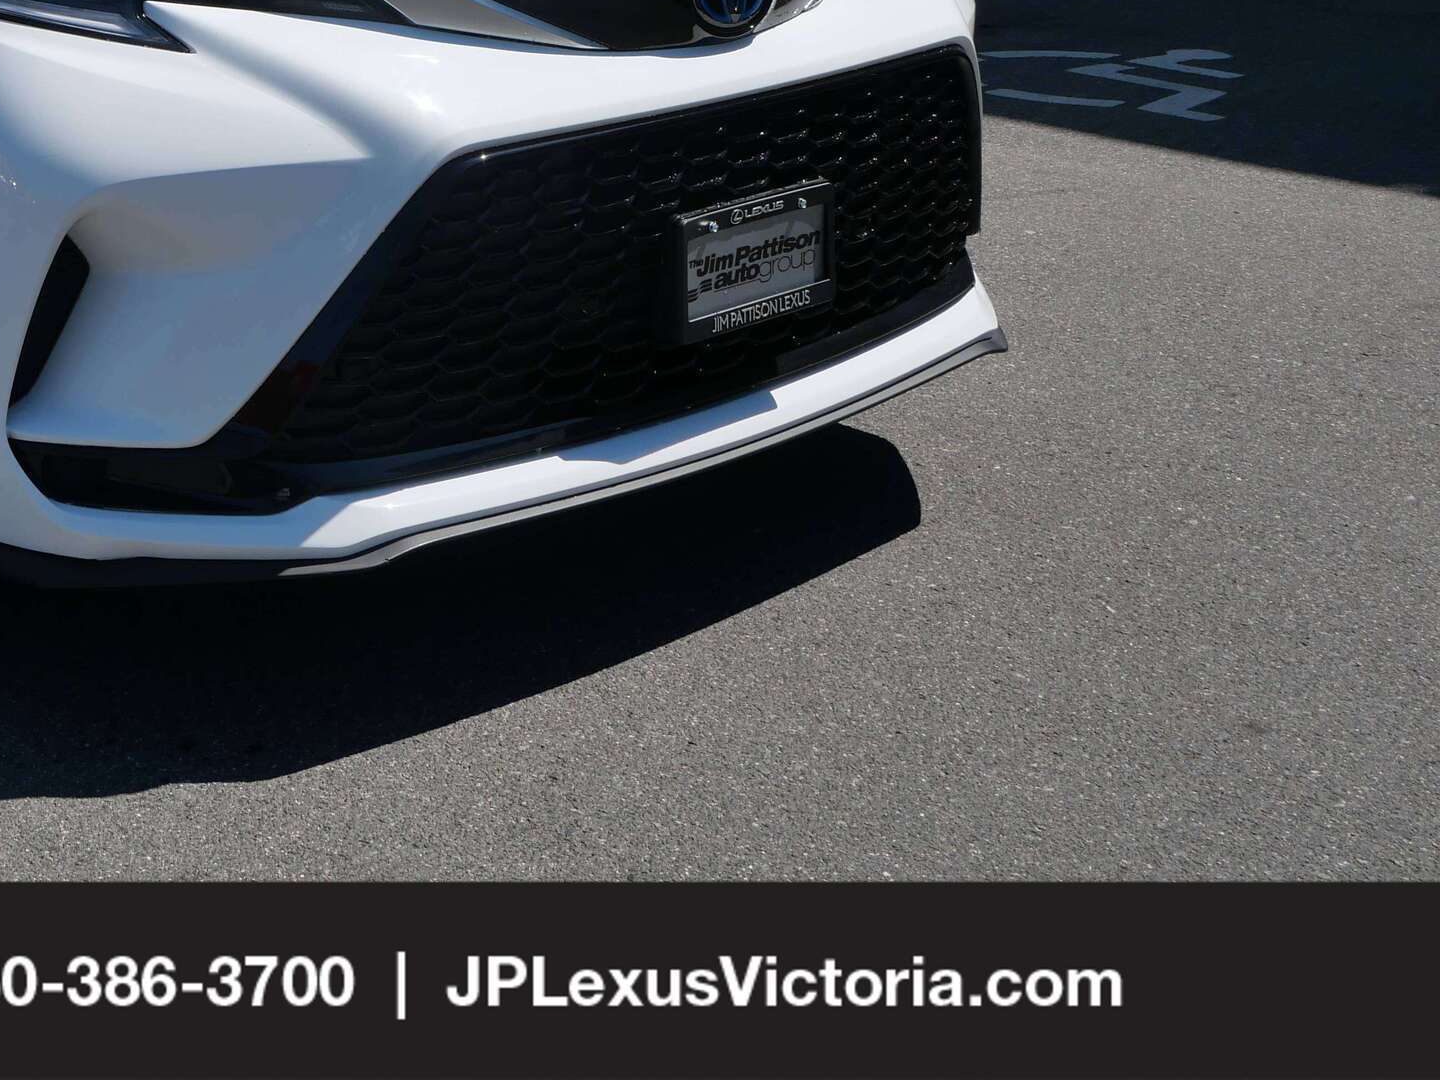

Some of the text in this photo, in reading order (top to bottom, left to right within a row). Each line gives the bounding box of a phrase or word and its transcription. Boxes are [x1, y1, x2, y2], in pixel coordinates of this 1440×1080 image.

[744, 200, 785, 218] LEXUS
[696, 252, 734, 278] Jim
[734, 229, 821, 267] Pattison
[712, 289, 812, 334] JIM PATTISON LEXUS
